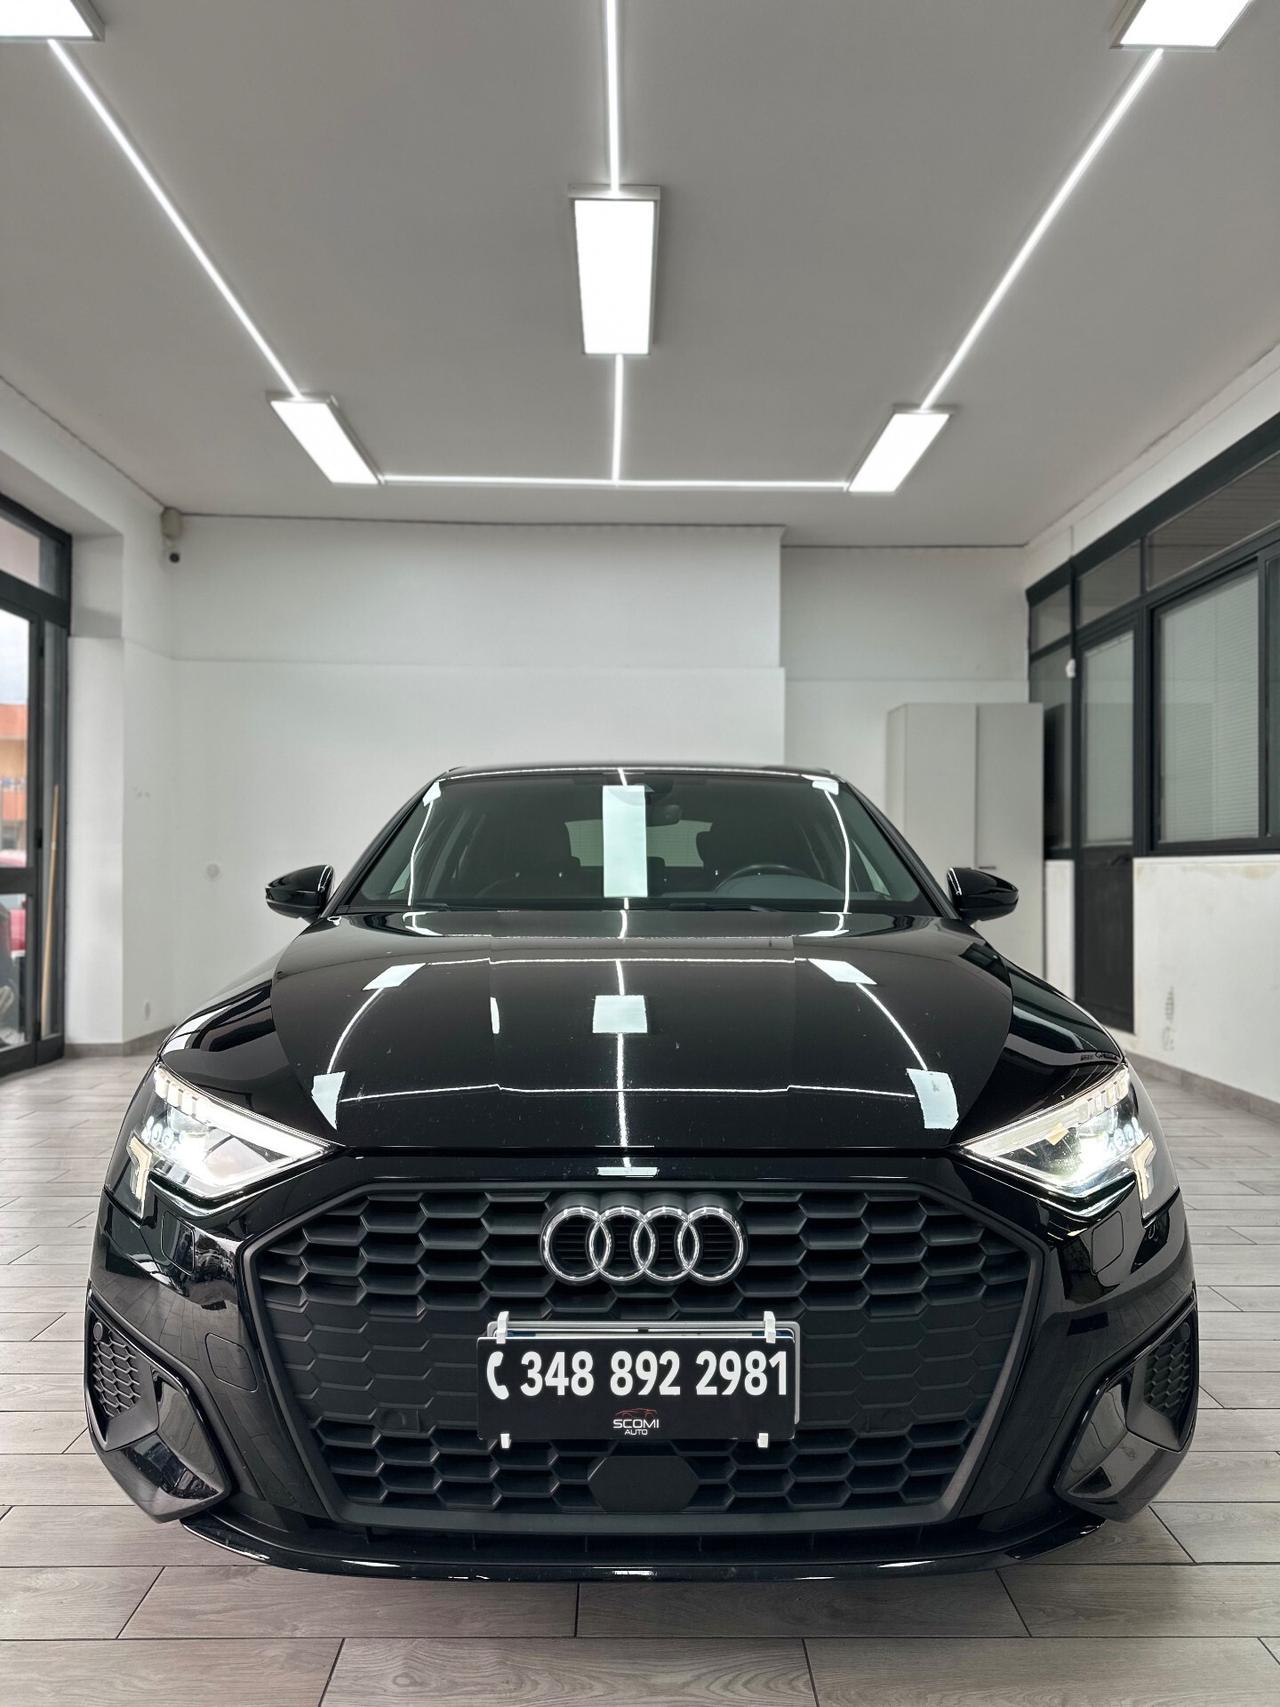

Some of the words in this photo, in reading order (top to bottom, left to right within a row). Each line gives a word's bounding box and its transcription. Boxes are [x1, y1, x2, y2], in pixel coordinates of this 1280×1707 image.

[520, 1350, 594, 1397] 348
[610, 1350, 681, 1396] 892
[695, 1350, 787, 1396] 2981
[612, 1418, 660, 1429] SCOMI
[624, 1428, 648, 1436] AUTO
